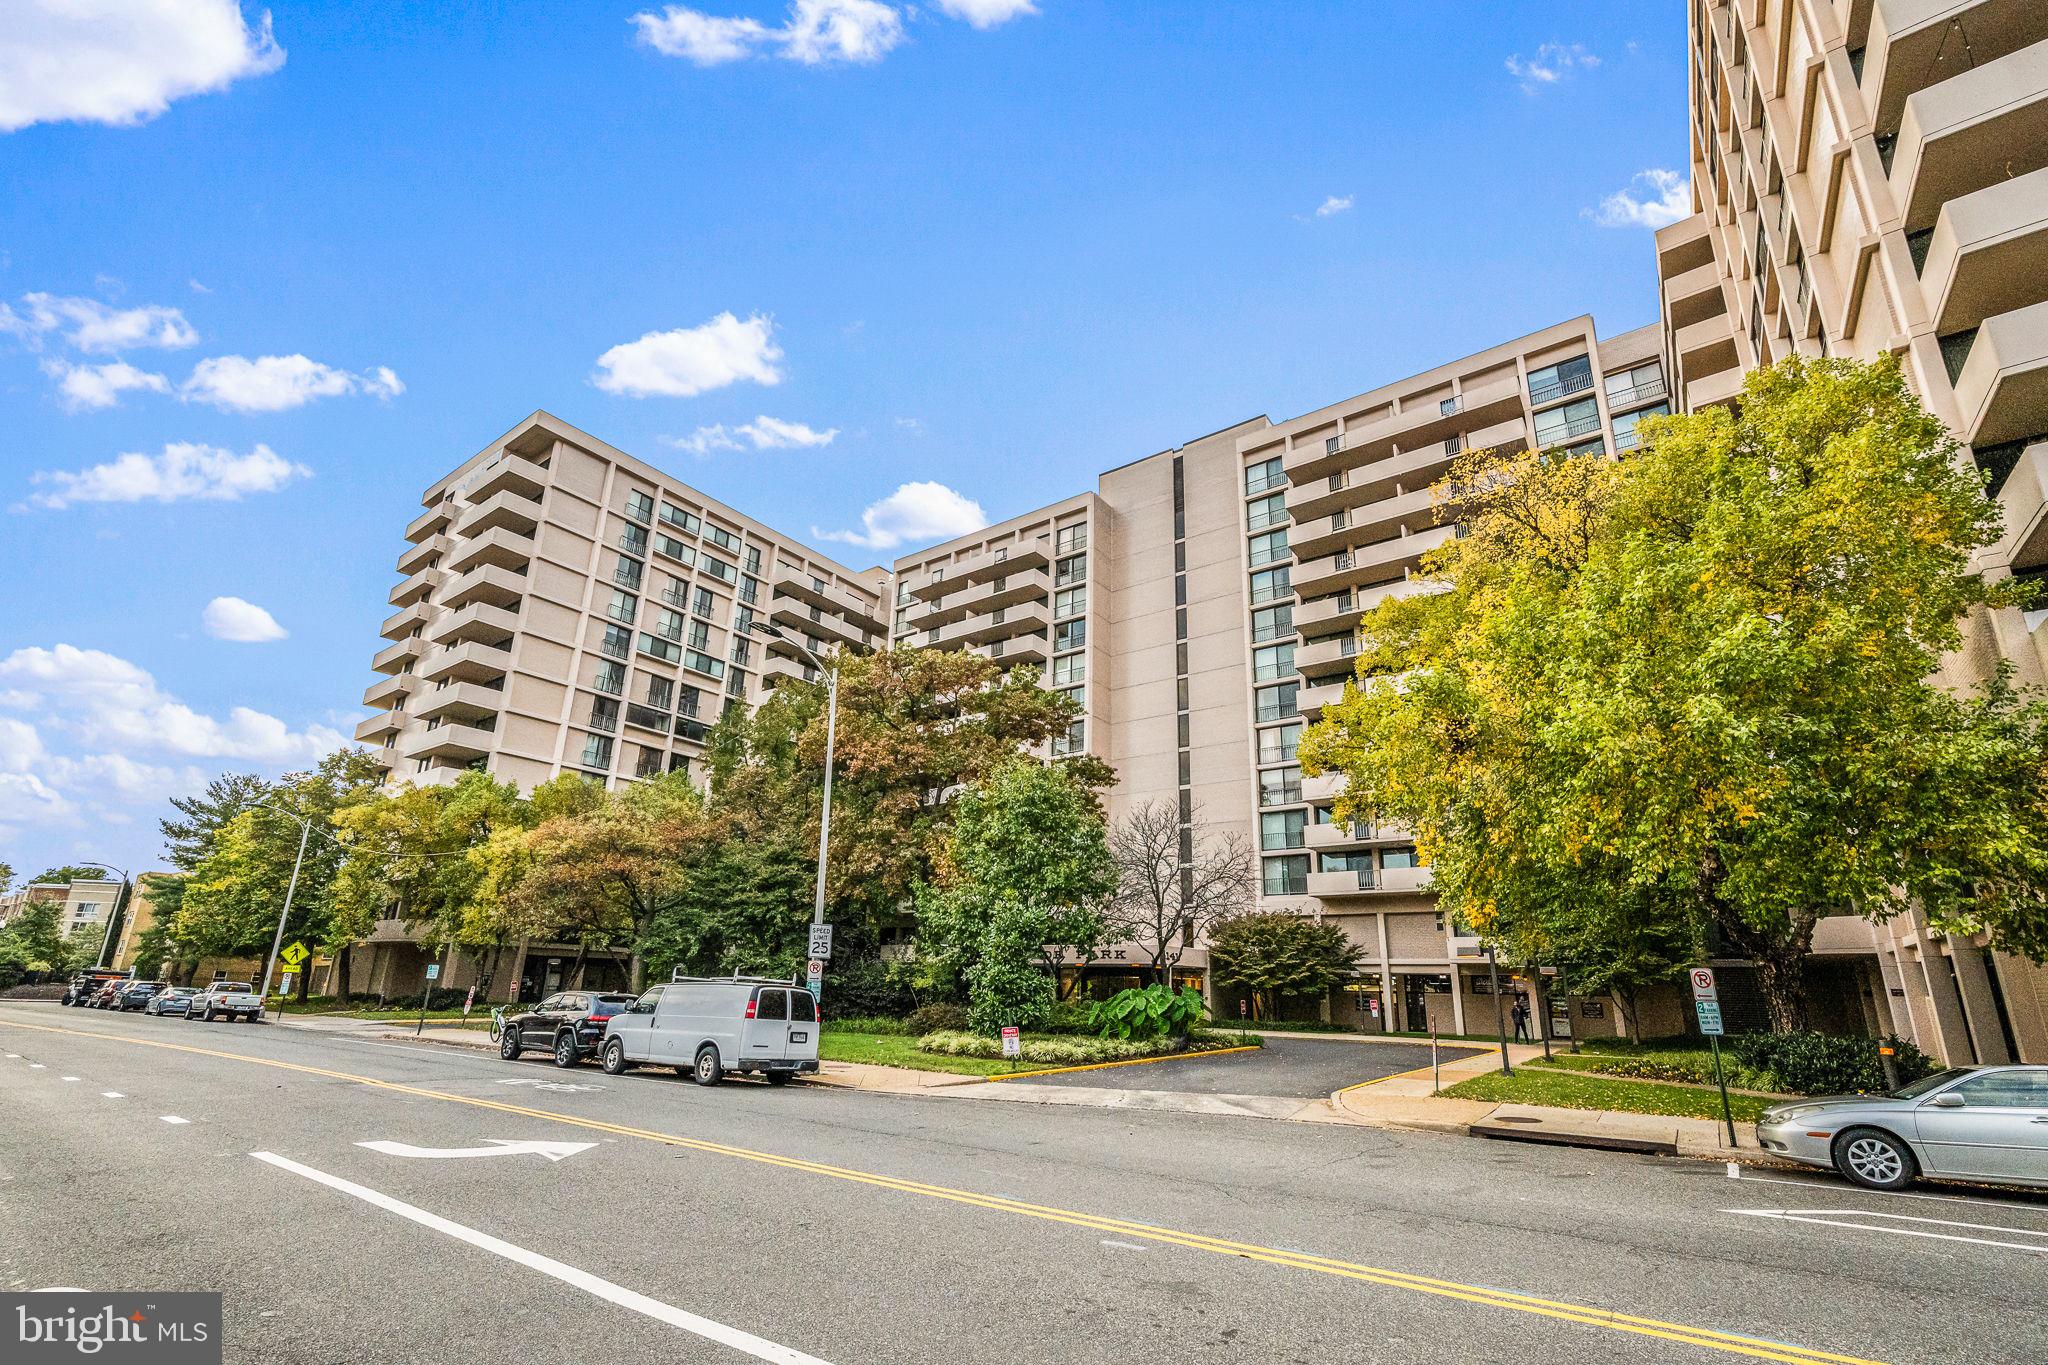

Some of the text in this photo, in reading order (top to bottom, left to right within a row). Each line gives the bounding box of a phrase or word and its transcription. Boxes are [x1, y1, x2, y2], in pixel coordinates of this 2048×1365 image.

[812, 927, 830, 935] SPEED
[811, 941, 829, 954] 25
[1698, 1003, 1704, 1013] 2
